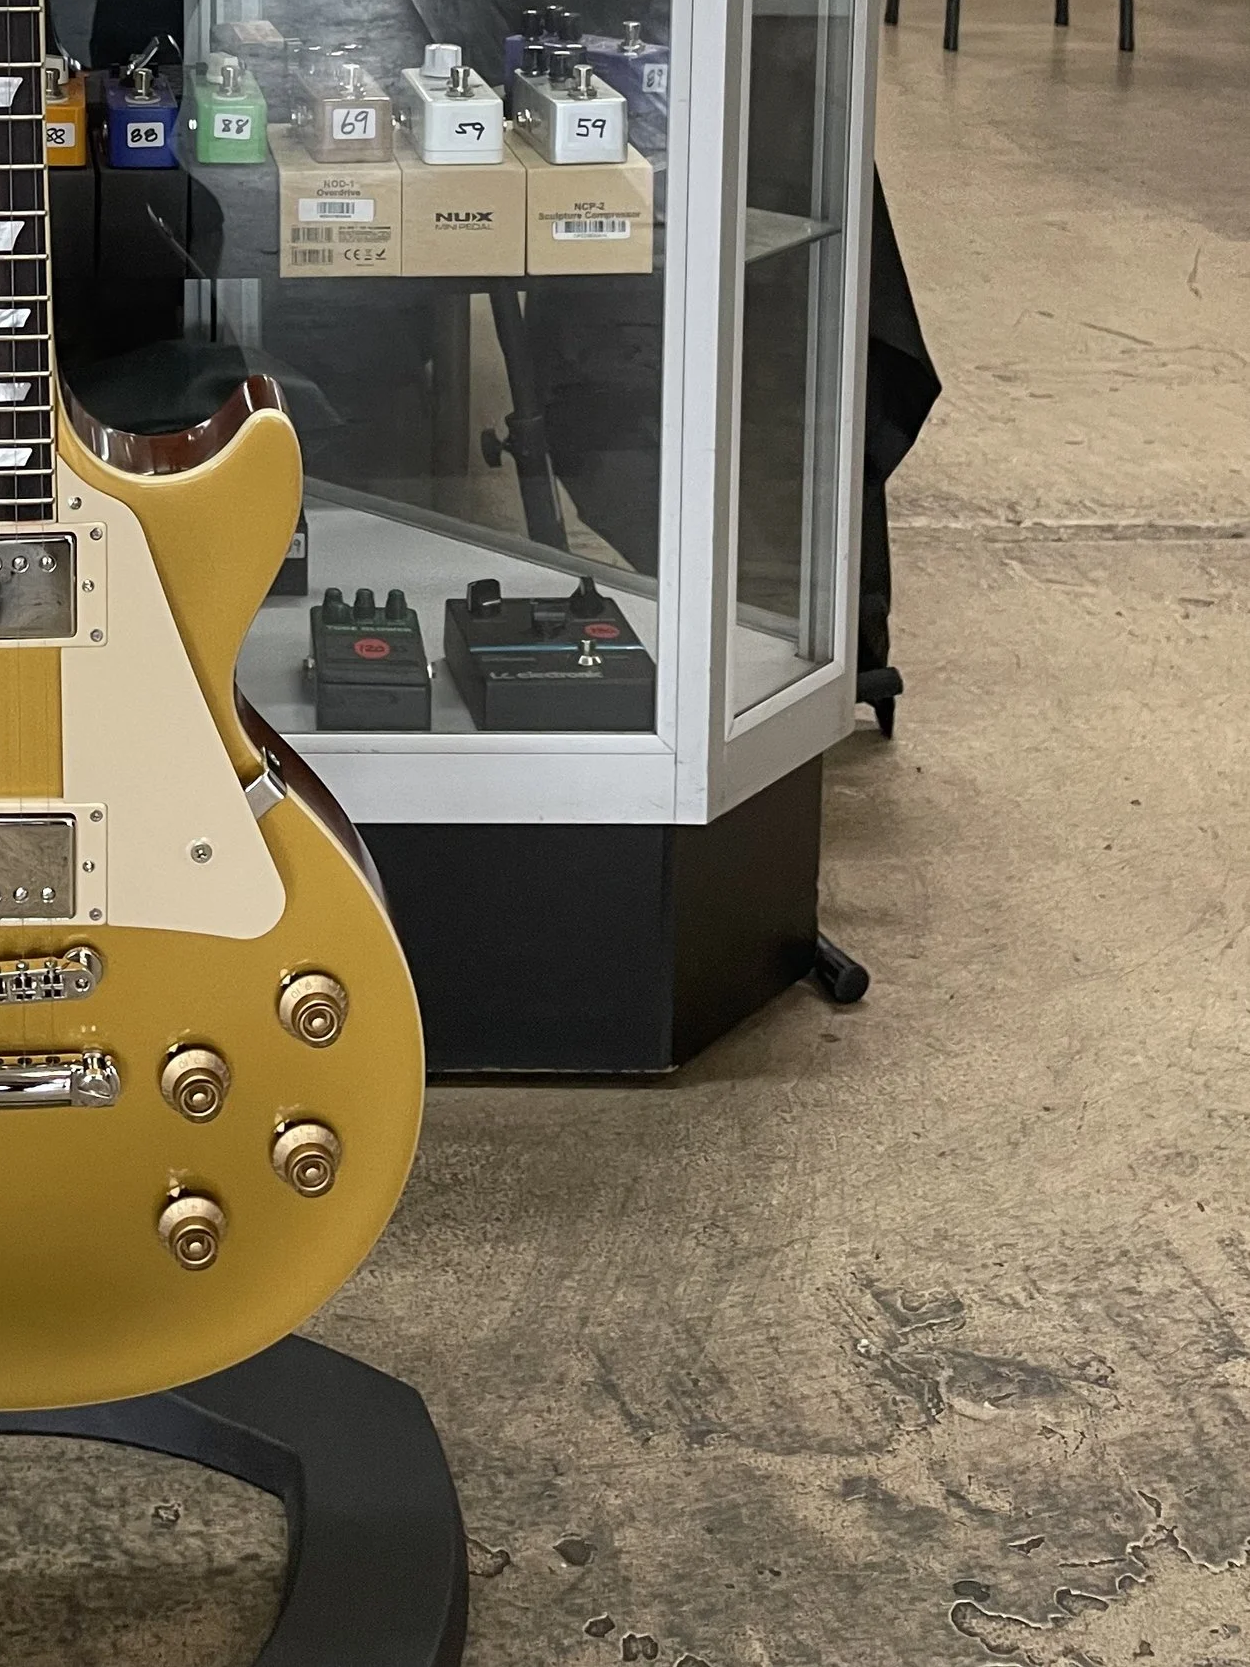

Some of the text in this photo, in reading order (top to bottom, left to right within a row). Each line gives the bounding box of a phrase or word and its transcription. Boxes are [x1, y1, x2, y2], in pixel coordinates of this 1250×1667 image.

[339, 108, 370, 136] 69
[575, 117, 607, 139] 59
[454, 122, 486, 141] 59
[316, 188, 361, 197] Overdrive
[435, 211, 494, 223] NUX
[538, 212, 582, 221] Sculpture
